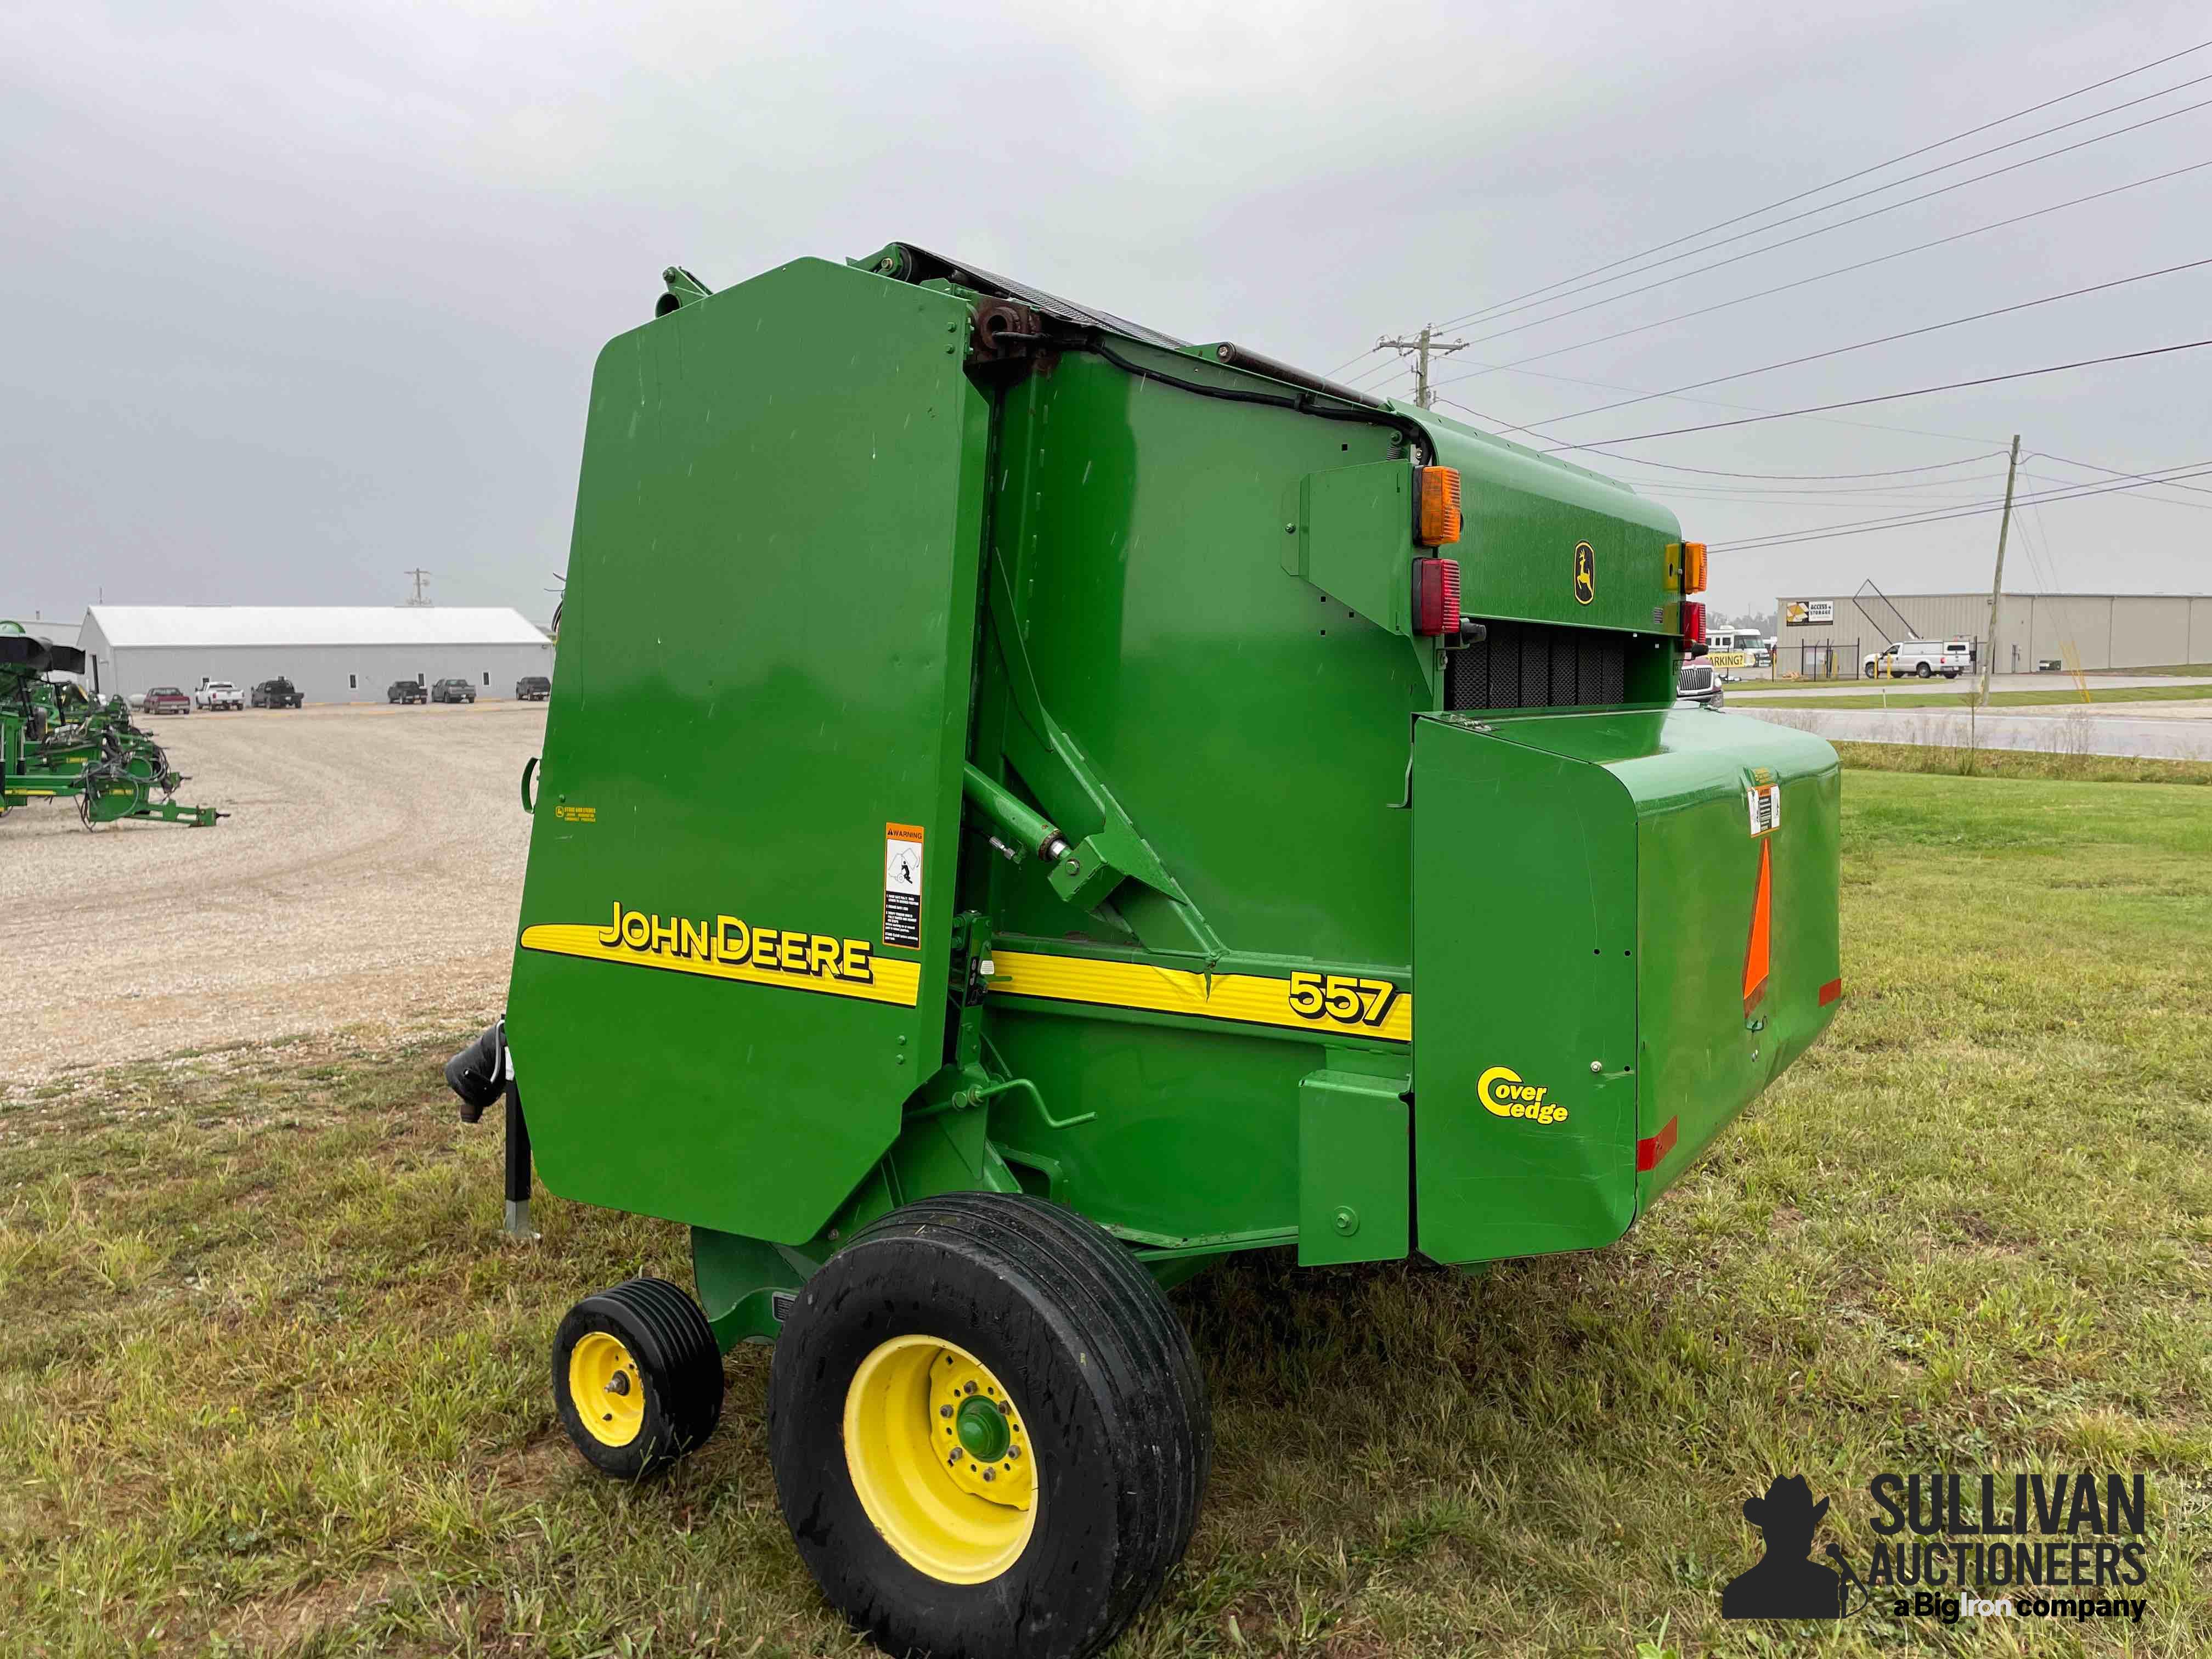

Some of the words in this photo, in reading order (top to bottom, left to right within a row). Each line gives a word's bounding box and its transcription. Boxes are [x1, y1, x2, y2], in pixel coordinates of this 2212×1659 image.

[1706, 655, 1743, 666] ARKING?
[893, 830, 922, 839] WARNING
[1289, 970, 1396, 1027] 557
[1477, 1065, 1548, 1118] Cover
[1509, 1101, 1568, 1125] edge
